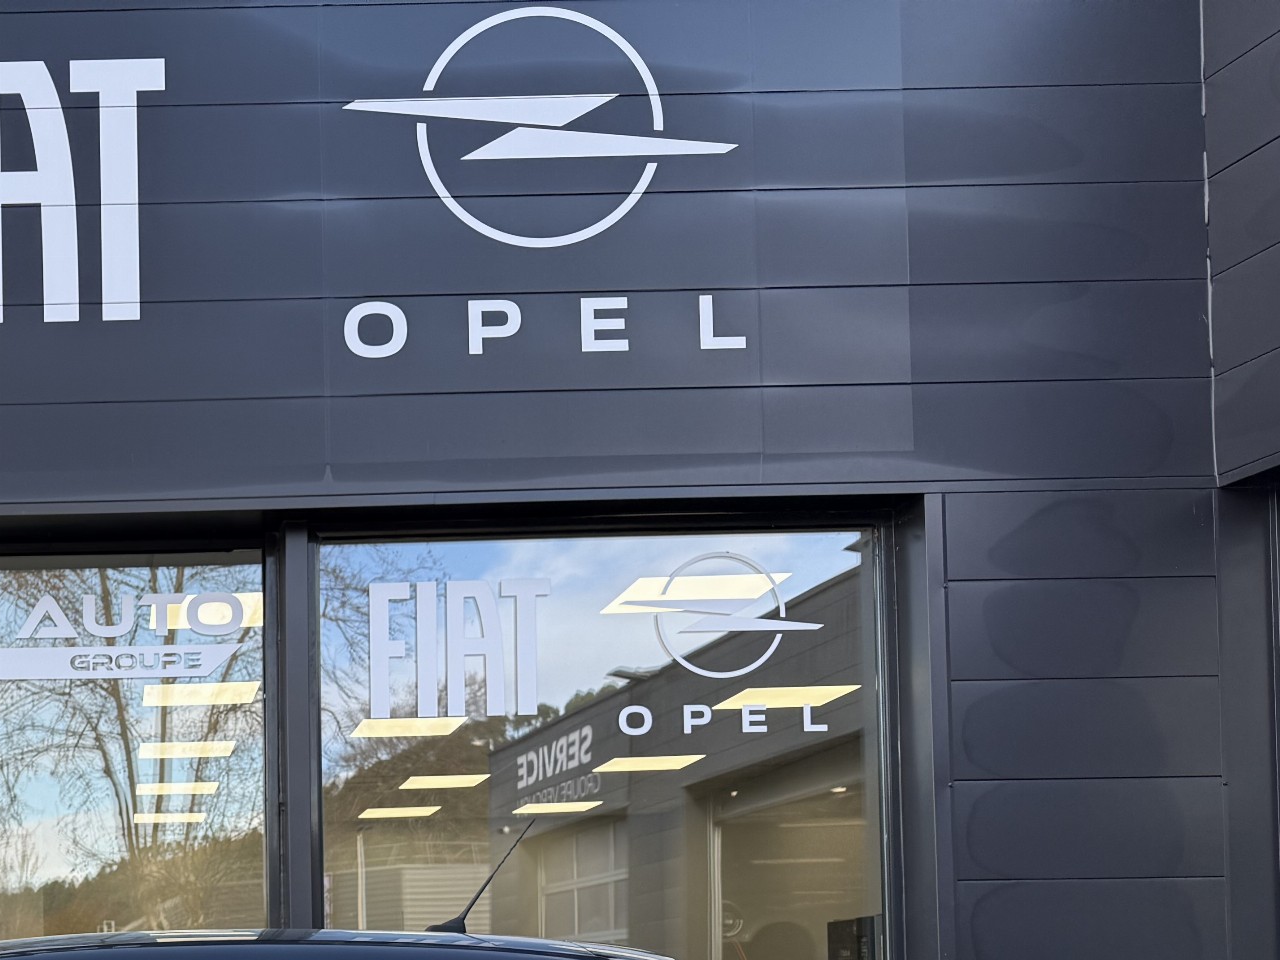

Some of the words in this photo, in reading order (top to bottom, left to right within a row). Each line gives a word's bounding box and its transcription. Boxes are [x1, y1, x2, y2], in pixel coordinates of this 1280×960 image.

[343, 294, 747, 359] OPEL
[17, 592, 244, 638] AUTO
[68, 650, 202, 672] GROUPE
[368, 578, 551, 719] FIAT
[618, 702, 829, 736] OPEL
